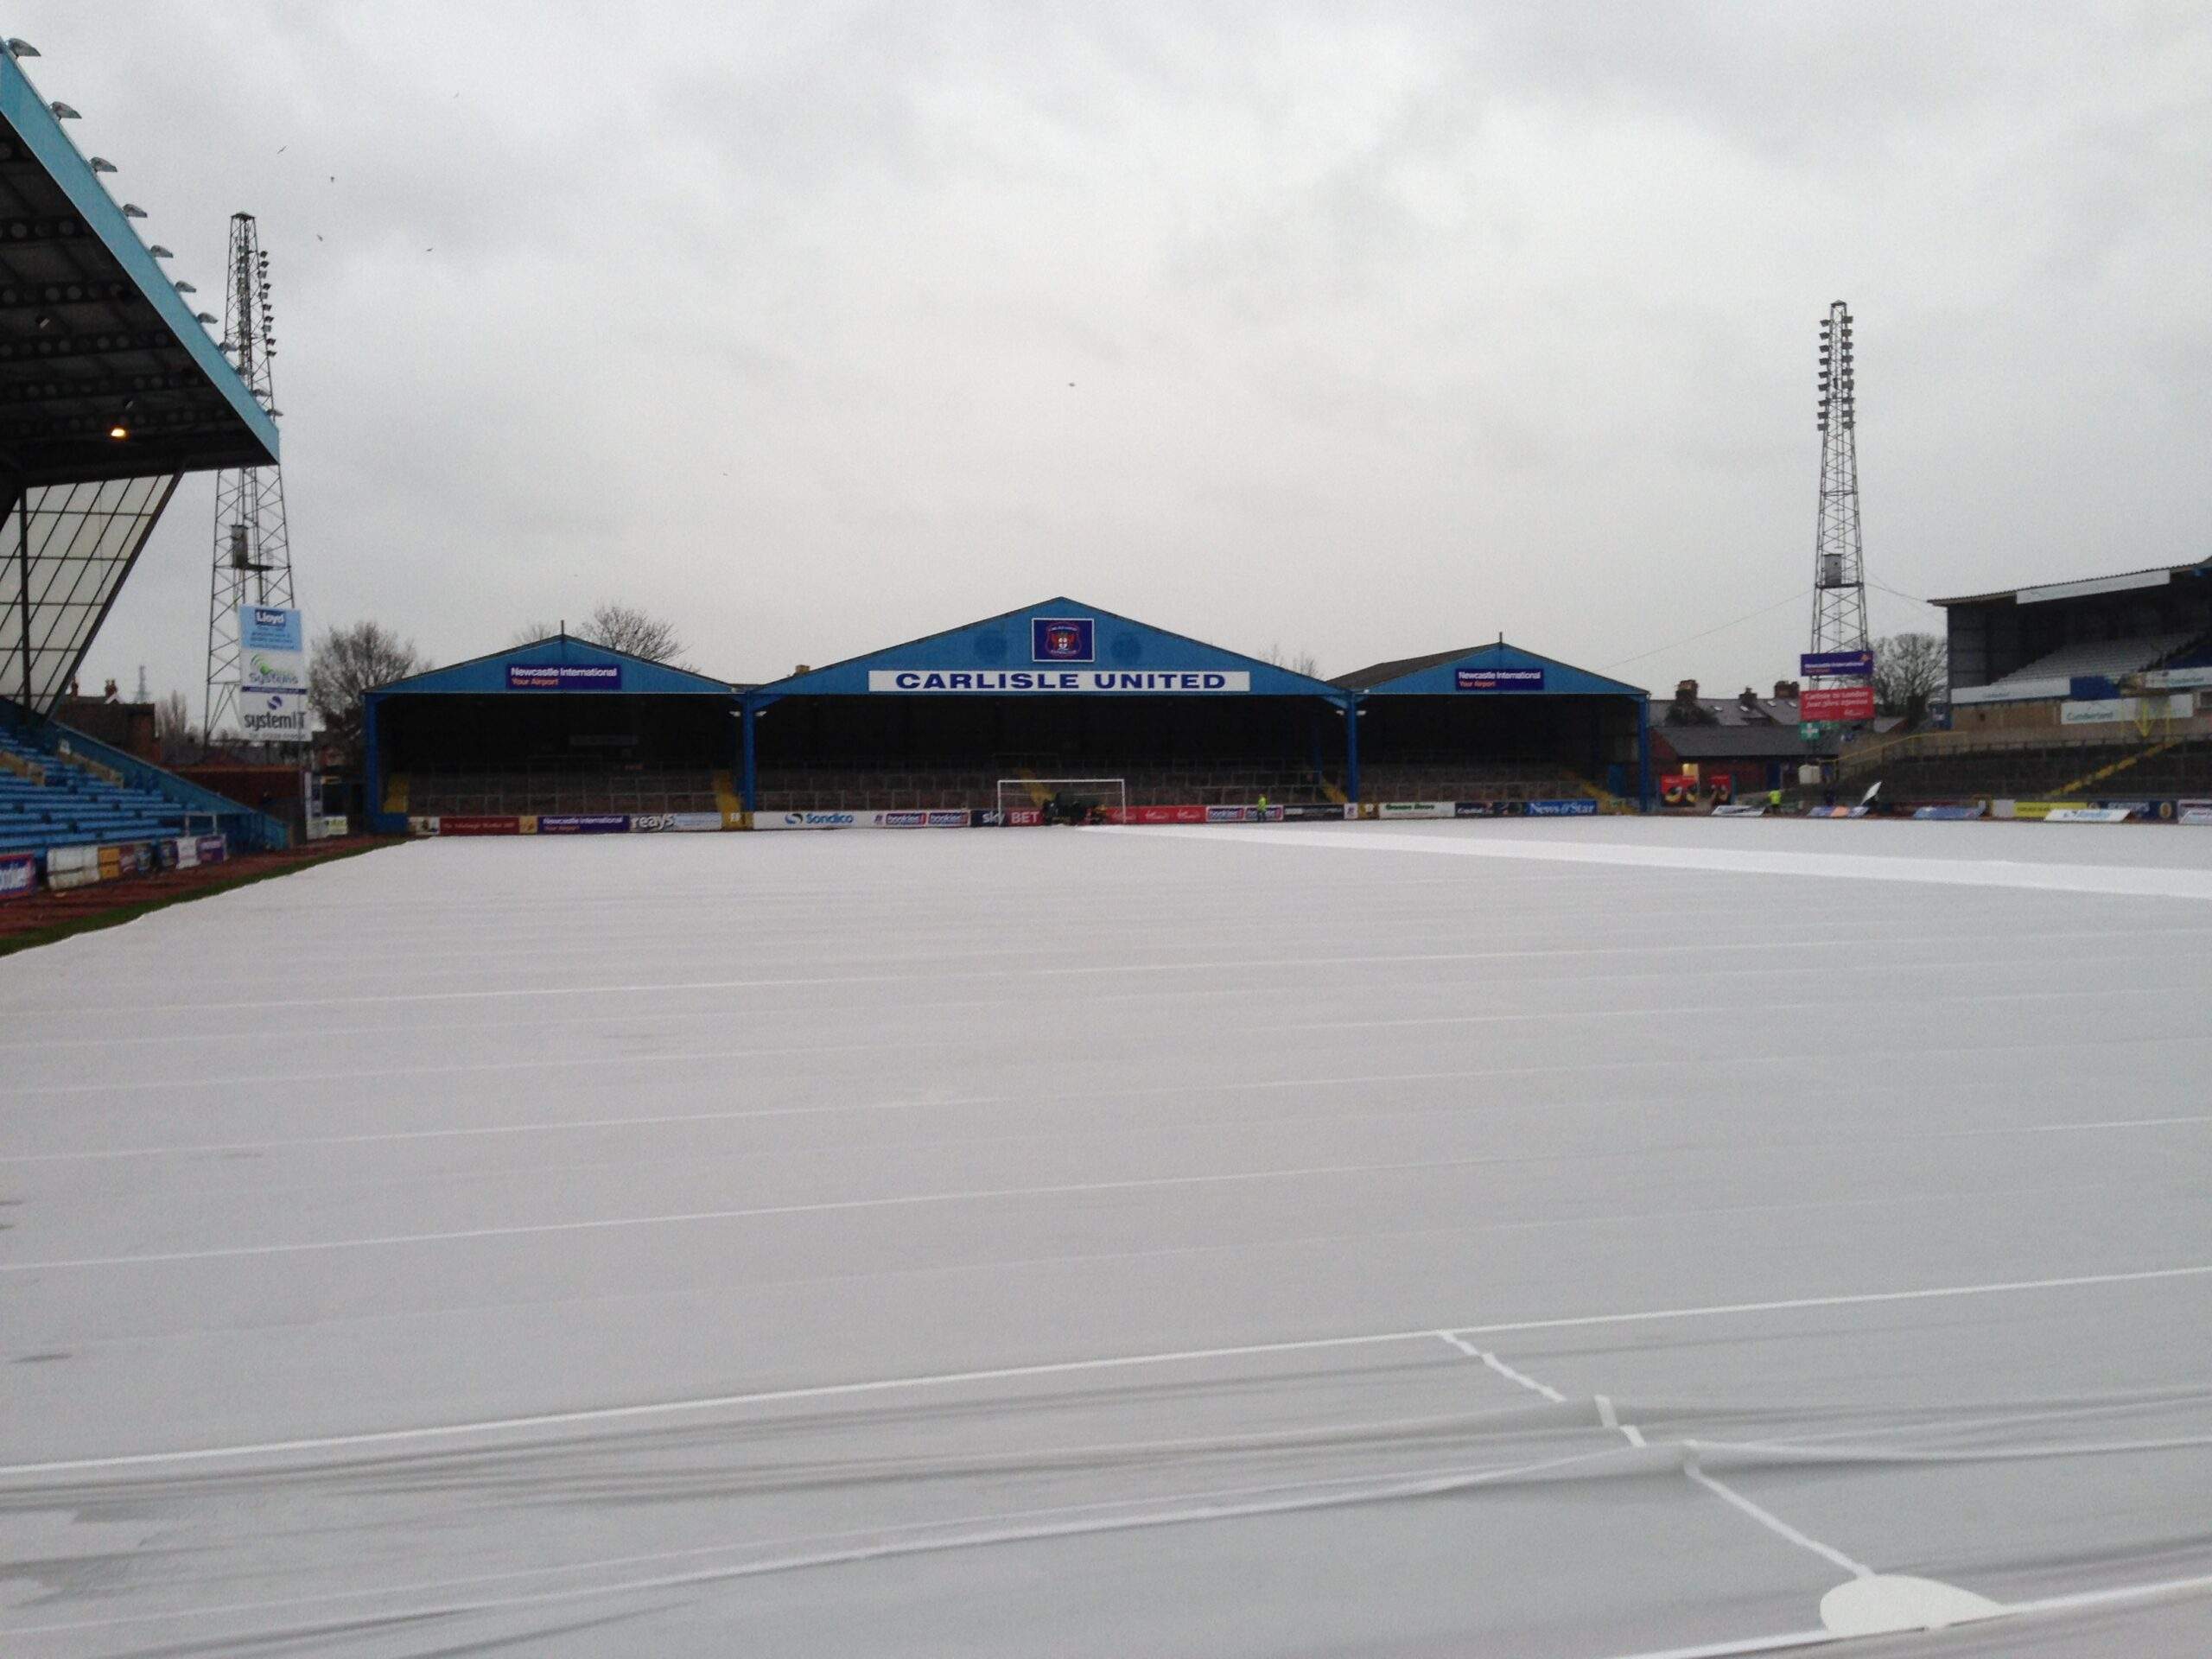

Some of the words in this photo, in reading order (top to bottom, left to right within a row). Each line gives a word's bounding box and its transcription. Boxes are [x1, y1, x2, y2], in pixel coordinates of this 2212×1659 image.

[511, 667, 559, 677] Newcastle
[560, 667, 617, 677] International
[895, 673, 1079, 690] CARLISLE
[1094, 673, 1225, 690] UNITED
[1011, 810, 1039, 823] BET
